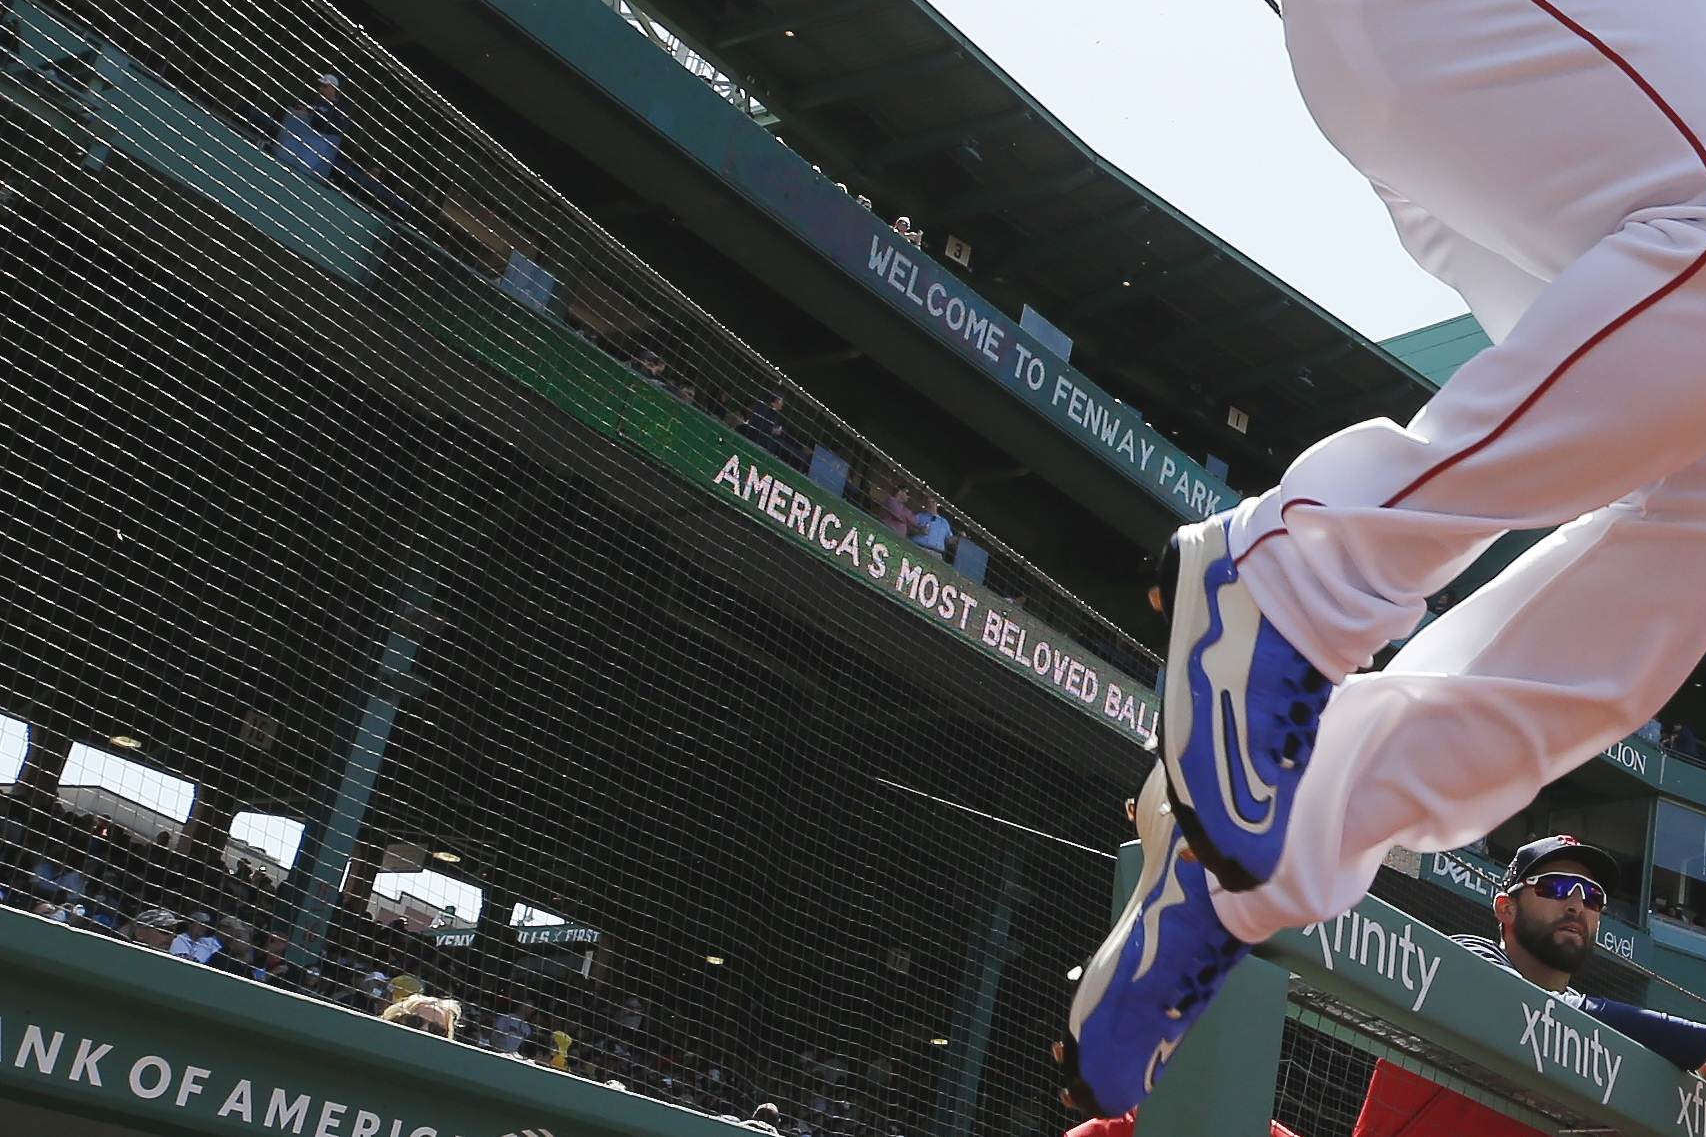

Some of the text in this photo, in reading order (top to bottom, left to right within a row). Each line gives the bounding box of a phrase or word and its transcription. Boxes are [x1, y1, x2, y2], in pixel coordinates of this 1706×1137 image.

[953, 239, 963, 259] 3
[868, 234, 1221, 518] WELCOME TO FENWAY PARK
[713, 454, 889, 580] AMERICA'S
[895, 558, 978, 631] MOST
[981, 608, 1099, 705] BELOVED
[1602, 742, 1647, 775] LION
[1596, 920, 1635, 959] Level
[0, 1018, 460, 1137] NK OF AMER
[1519, 999, 1622, 1105] xfinity
